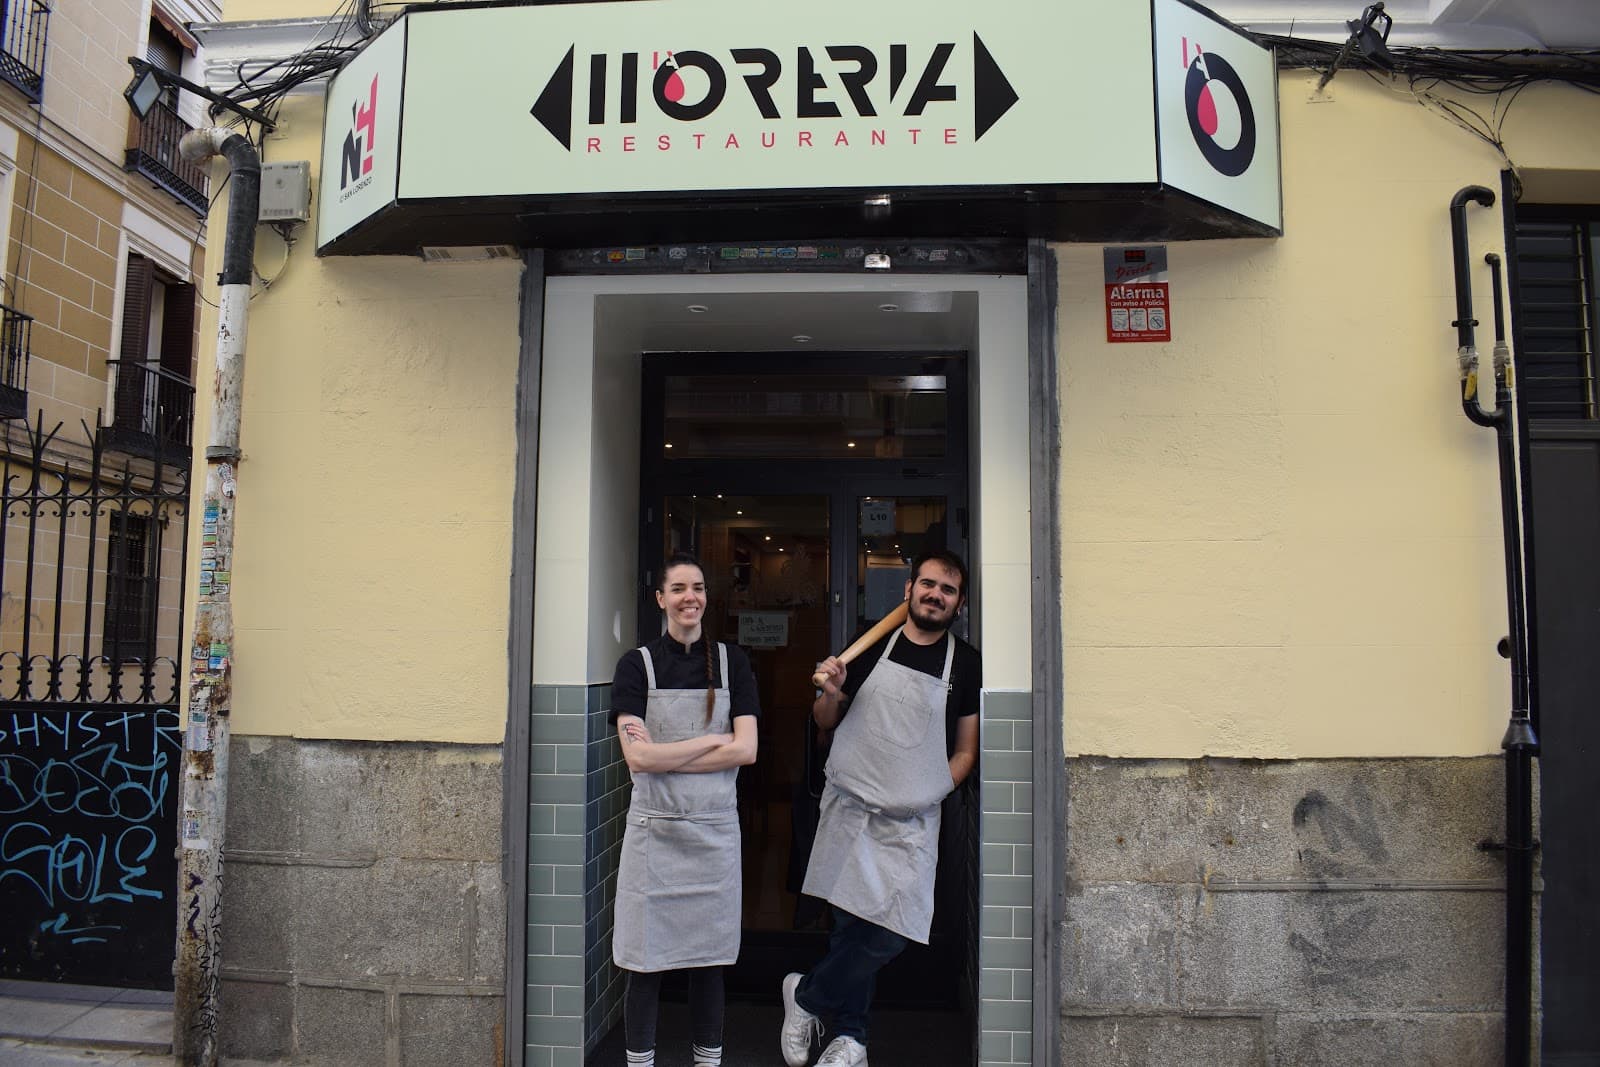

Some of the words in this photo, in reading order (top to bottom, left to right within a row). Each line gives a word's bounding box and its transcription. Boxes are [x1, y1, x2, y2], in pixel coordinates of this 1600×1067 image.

[587, 128, 958, 153] RESTAURANTE
[1111, 286, 1164, 299] Alarma
[870, 513, 887, 521] L10
